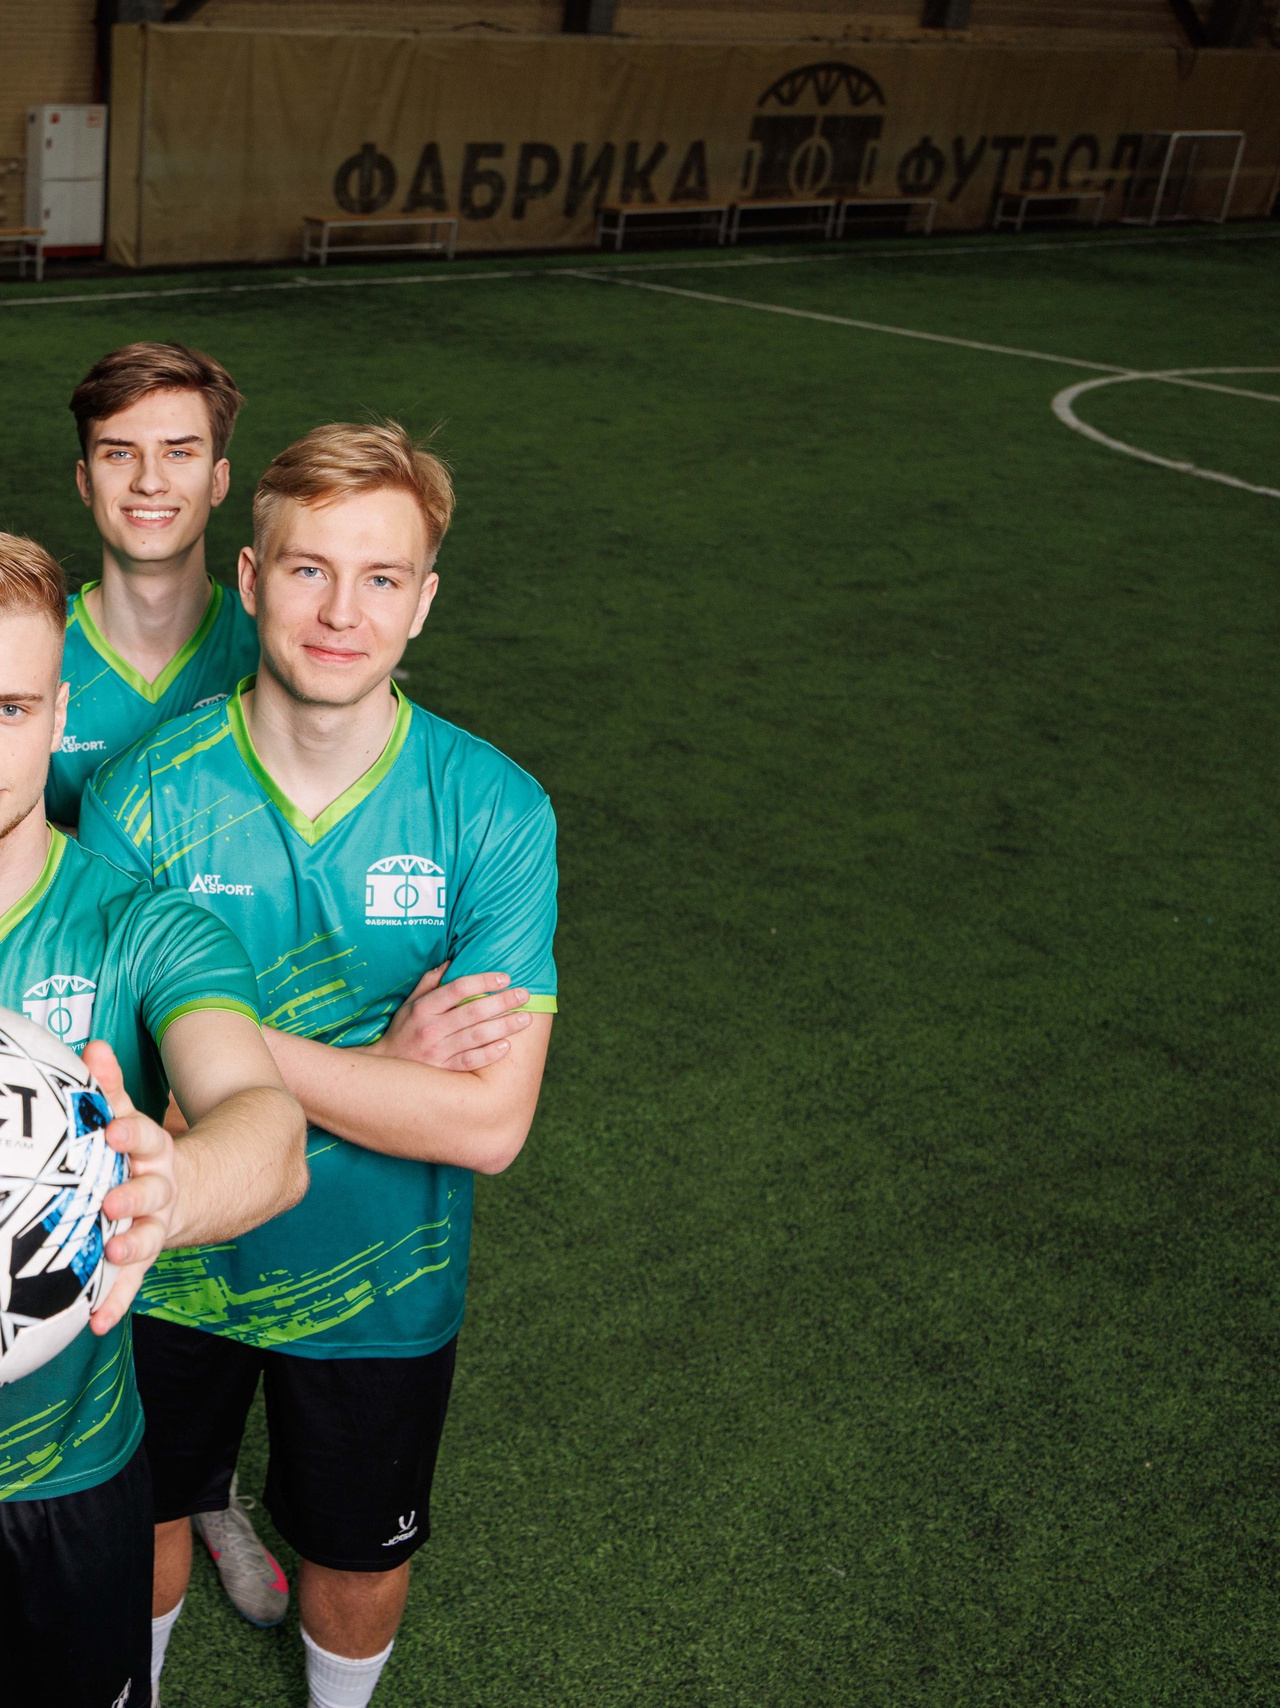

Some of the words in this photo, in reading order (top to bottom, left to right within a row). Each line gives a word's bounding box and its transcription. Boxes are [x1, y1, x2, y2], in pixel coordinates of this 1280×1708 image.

[333, 141, 710, 220] ФАБРИКА
[208, 883, 254, 896] SPORT.
[365, 918, 402, 926] ФАБРИКА
[408, 918, 445, 926] ФУТБОЛА
